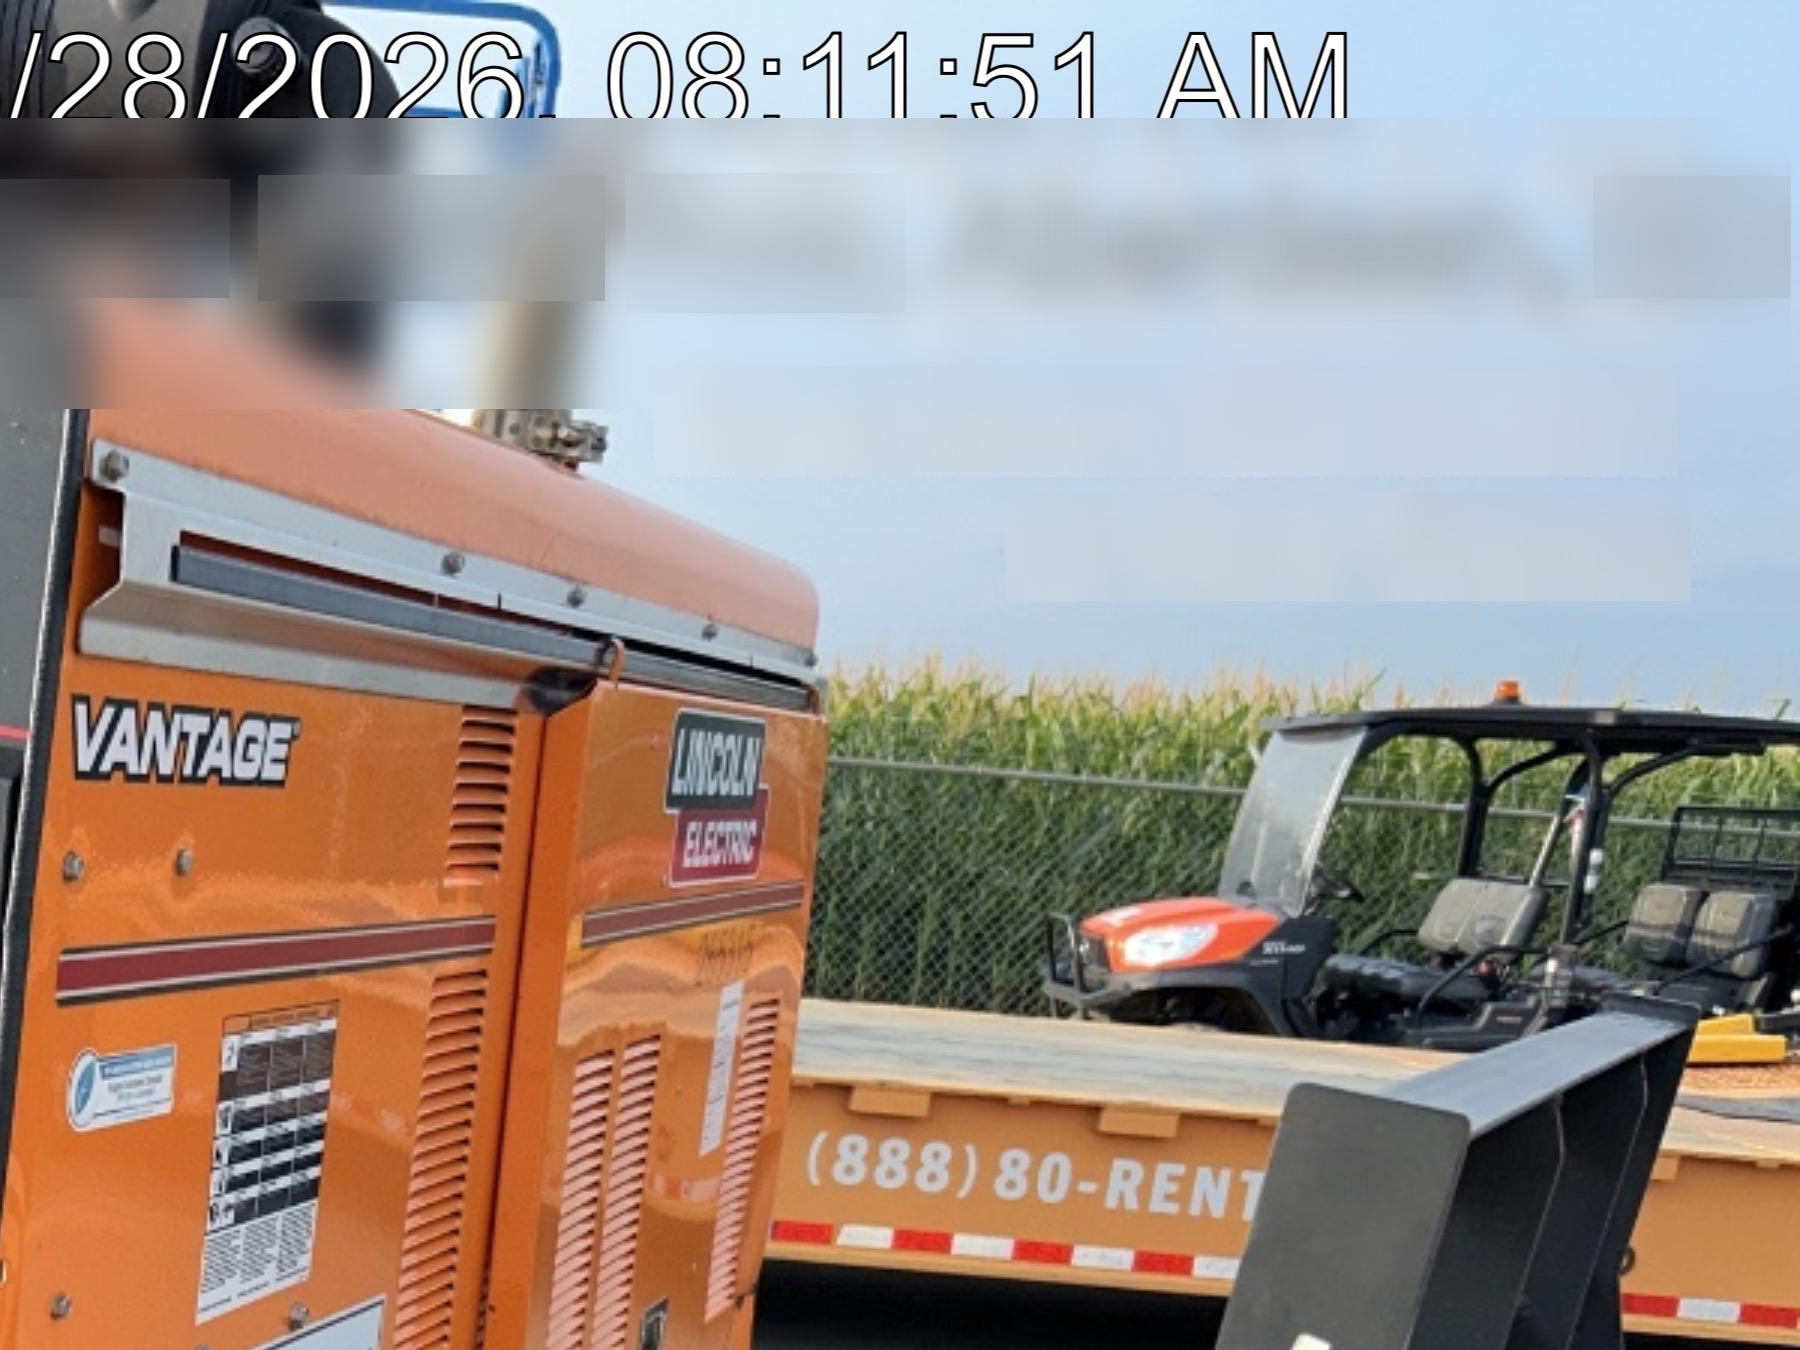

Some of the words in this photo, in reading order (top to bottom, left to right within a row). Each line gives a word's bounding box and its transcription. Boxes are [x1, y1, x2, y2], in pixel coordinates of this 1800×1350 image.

[73, 697, 296, 785] VANTAGE
[671, 727, 764, 797] LINCOLN
[682, 817, 758, 868] ELECTRIC
[806, 1130, 979, 1200] (888)
[994, 1149, 1266, 1222] 80-RENT
